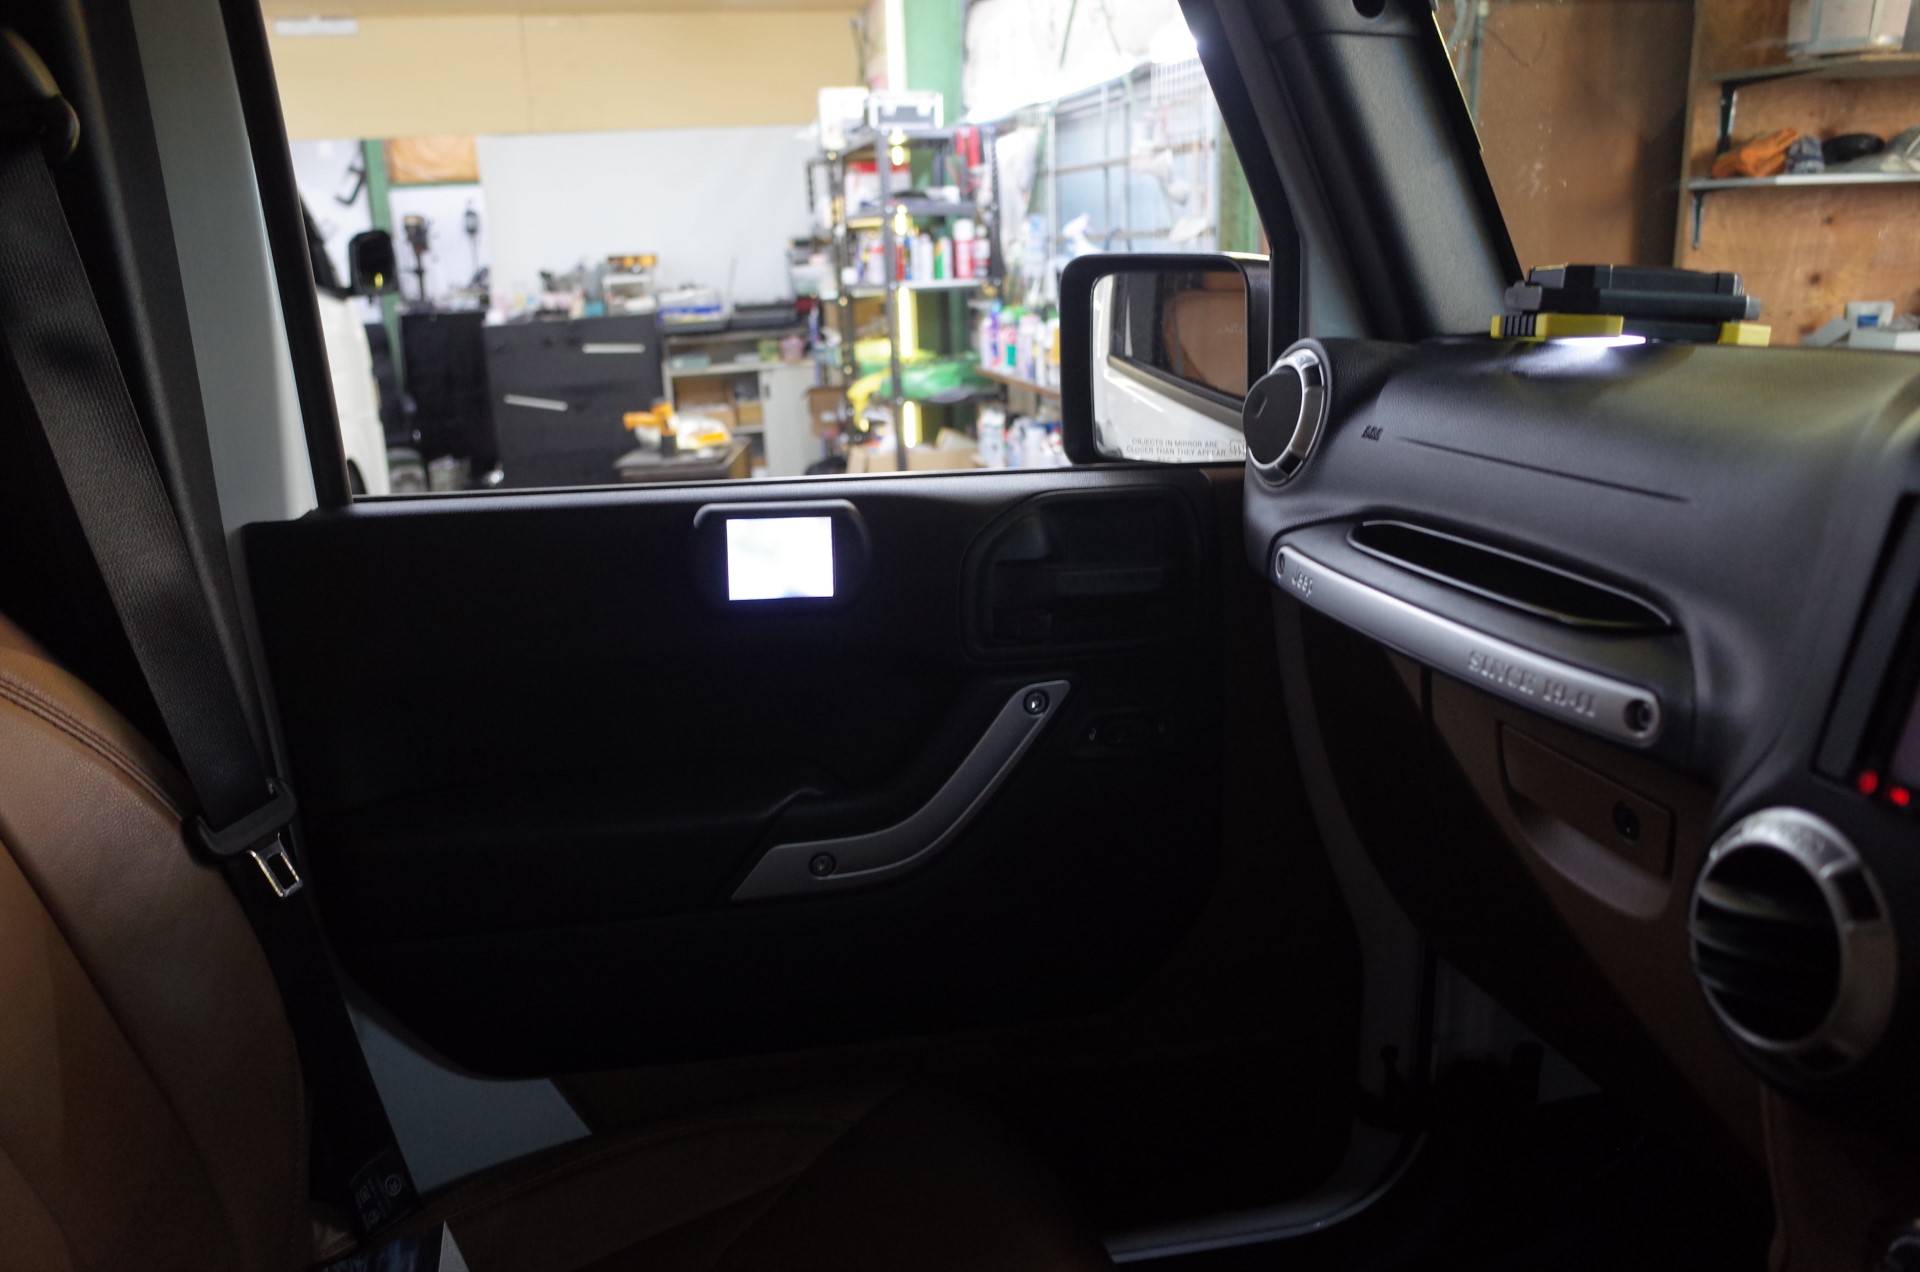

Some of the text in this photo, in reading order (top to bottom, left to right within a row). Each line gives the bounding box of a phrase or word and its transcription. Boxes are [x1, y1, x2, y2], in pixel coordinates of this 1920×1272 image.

[1166, 439, 1173, 447] IN
[1175, 439, 1202, 448] MIRROR
[1156, 447, 1175, 456] THAN
[1176, 448, 1195, 456] THEY
[1198, 448, 1226, 457] APPEAR
[1468, 649, 1536, 695] SINCE
